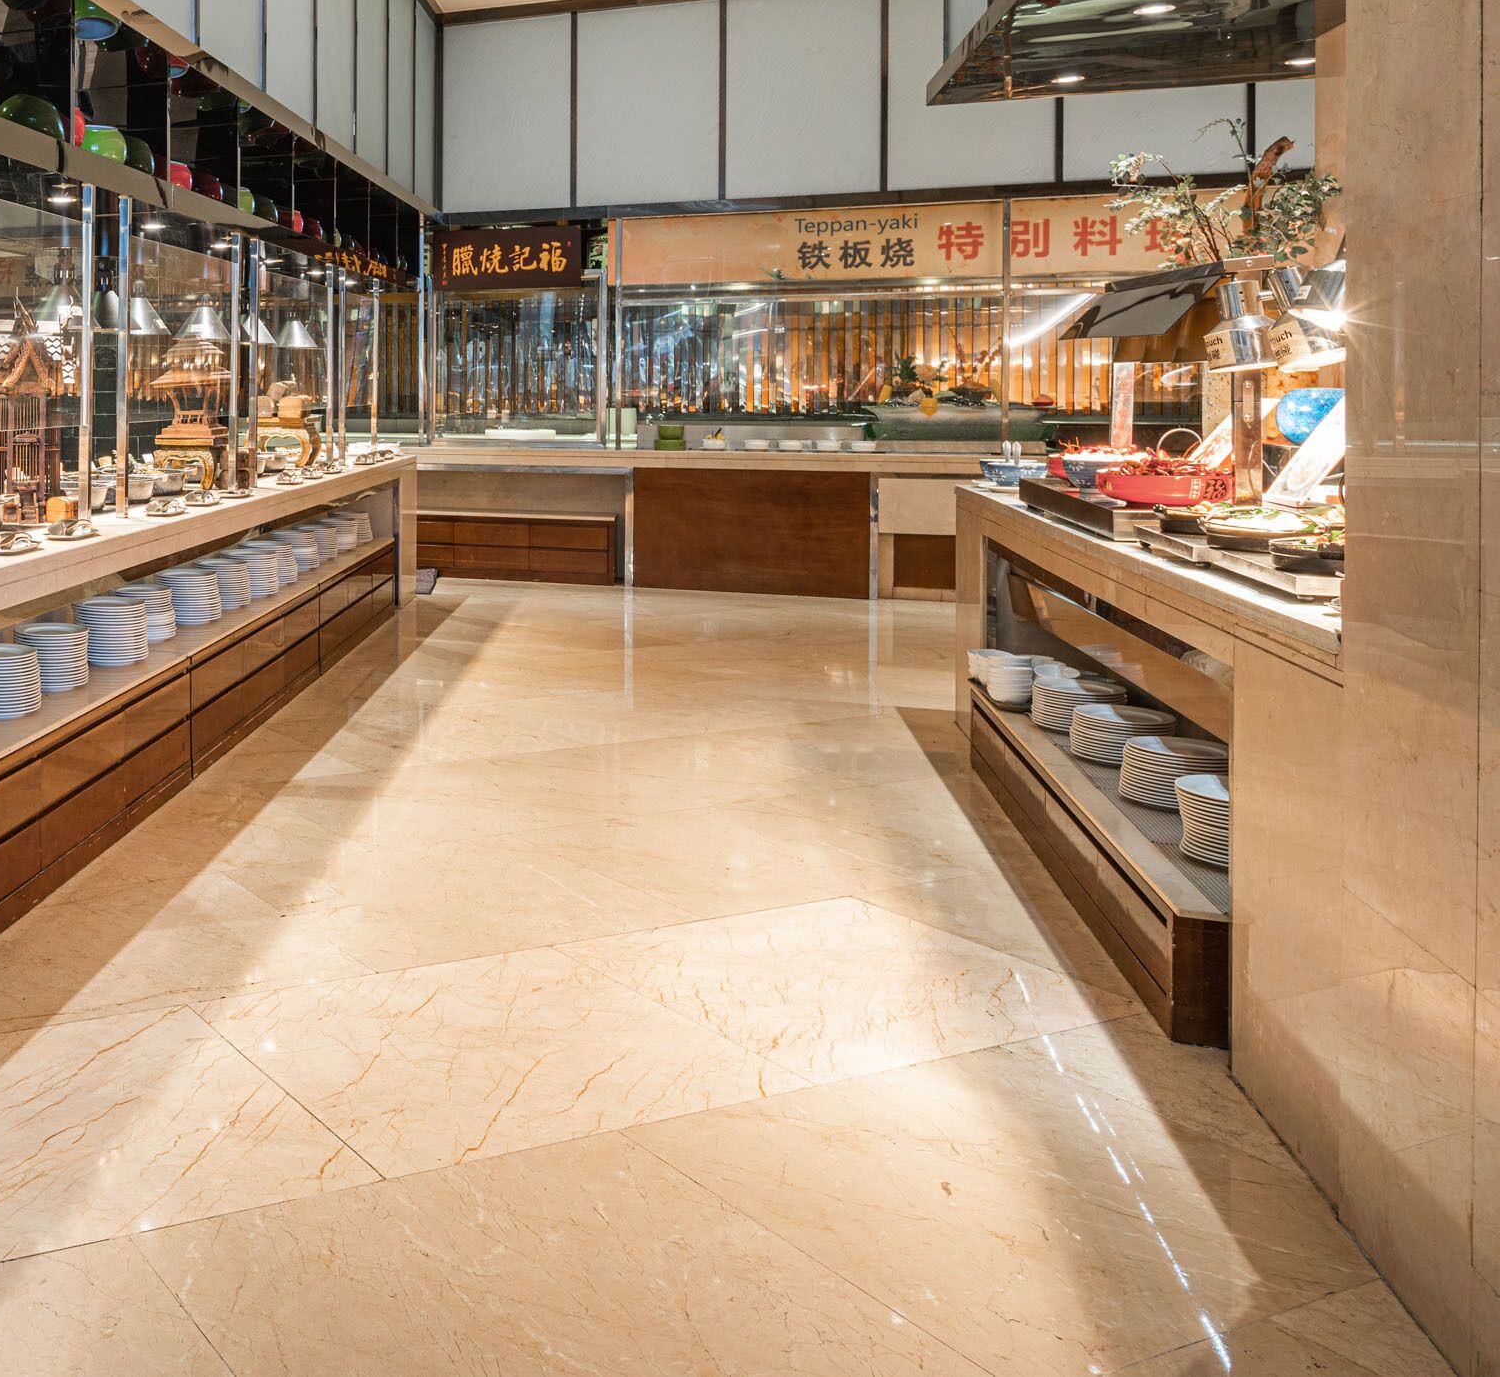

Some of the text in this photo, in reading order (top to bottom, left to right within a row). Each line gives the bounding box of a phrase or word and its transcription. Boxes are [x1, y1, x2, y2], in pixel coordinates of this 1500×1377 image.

[795, 213, 919, 237] Teppan-yaki
[797, 238, 916, 270] 铁板烧
